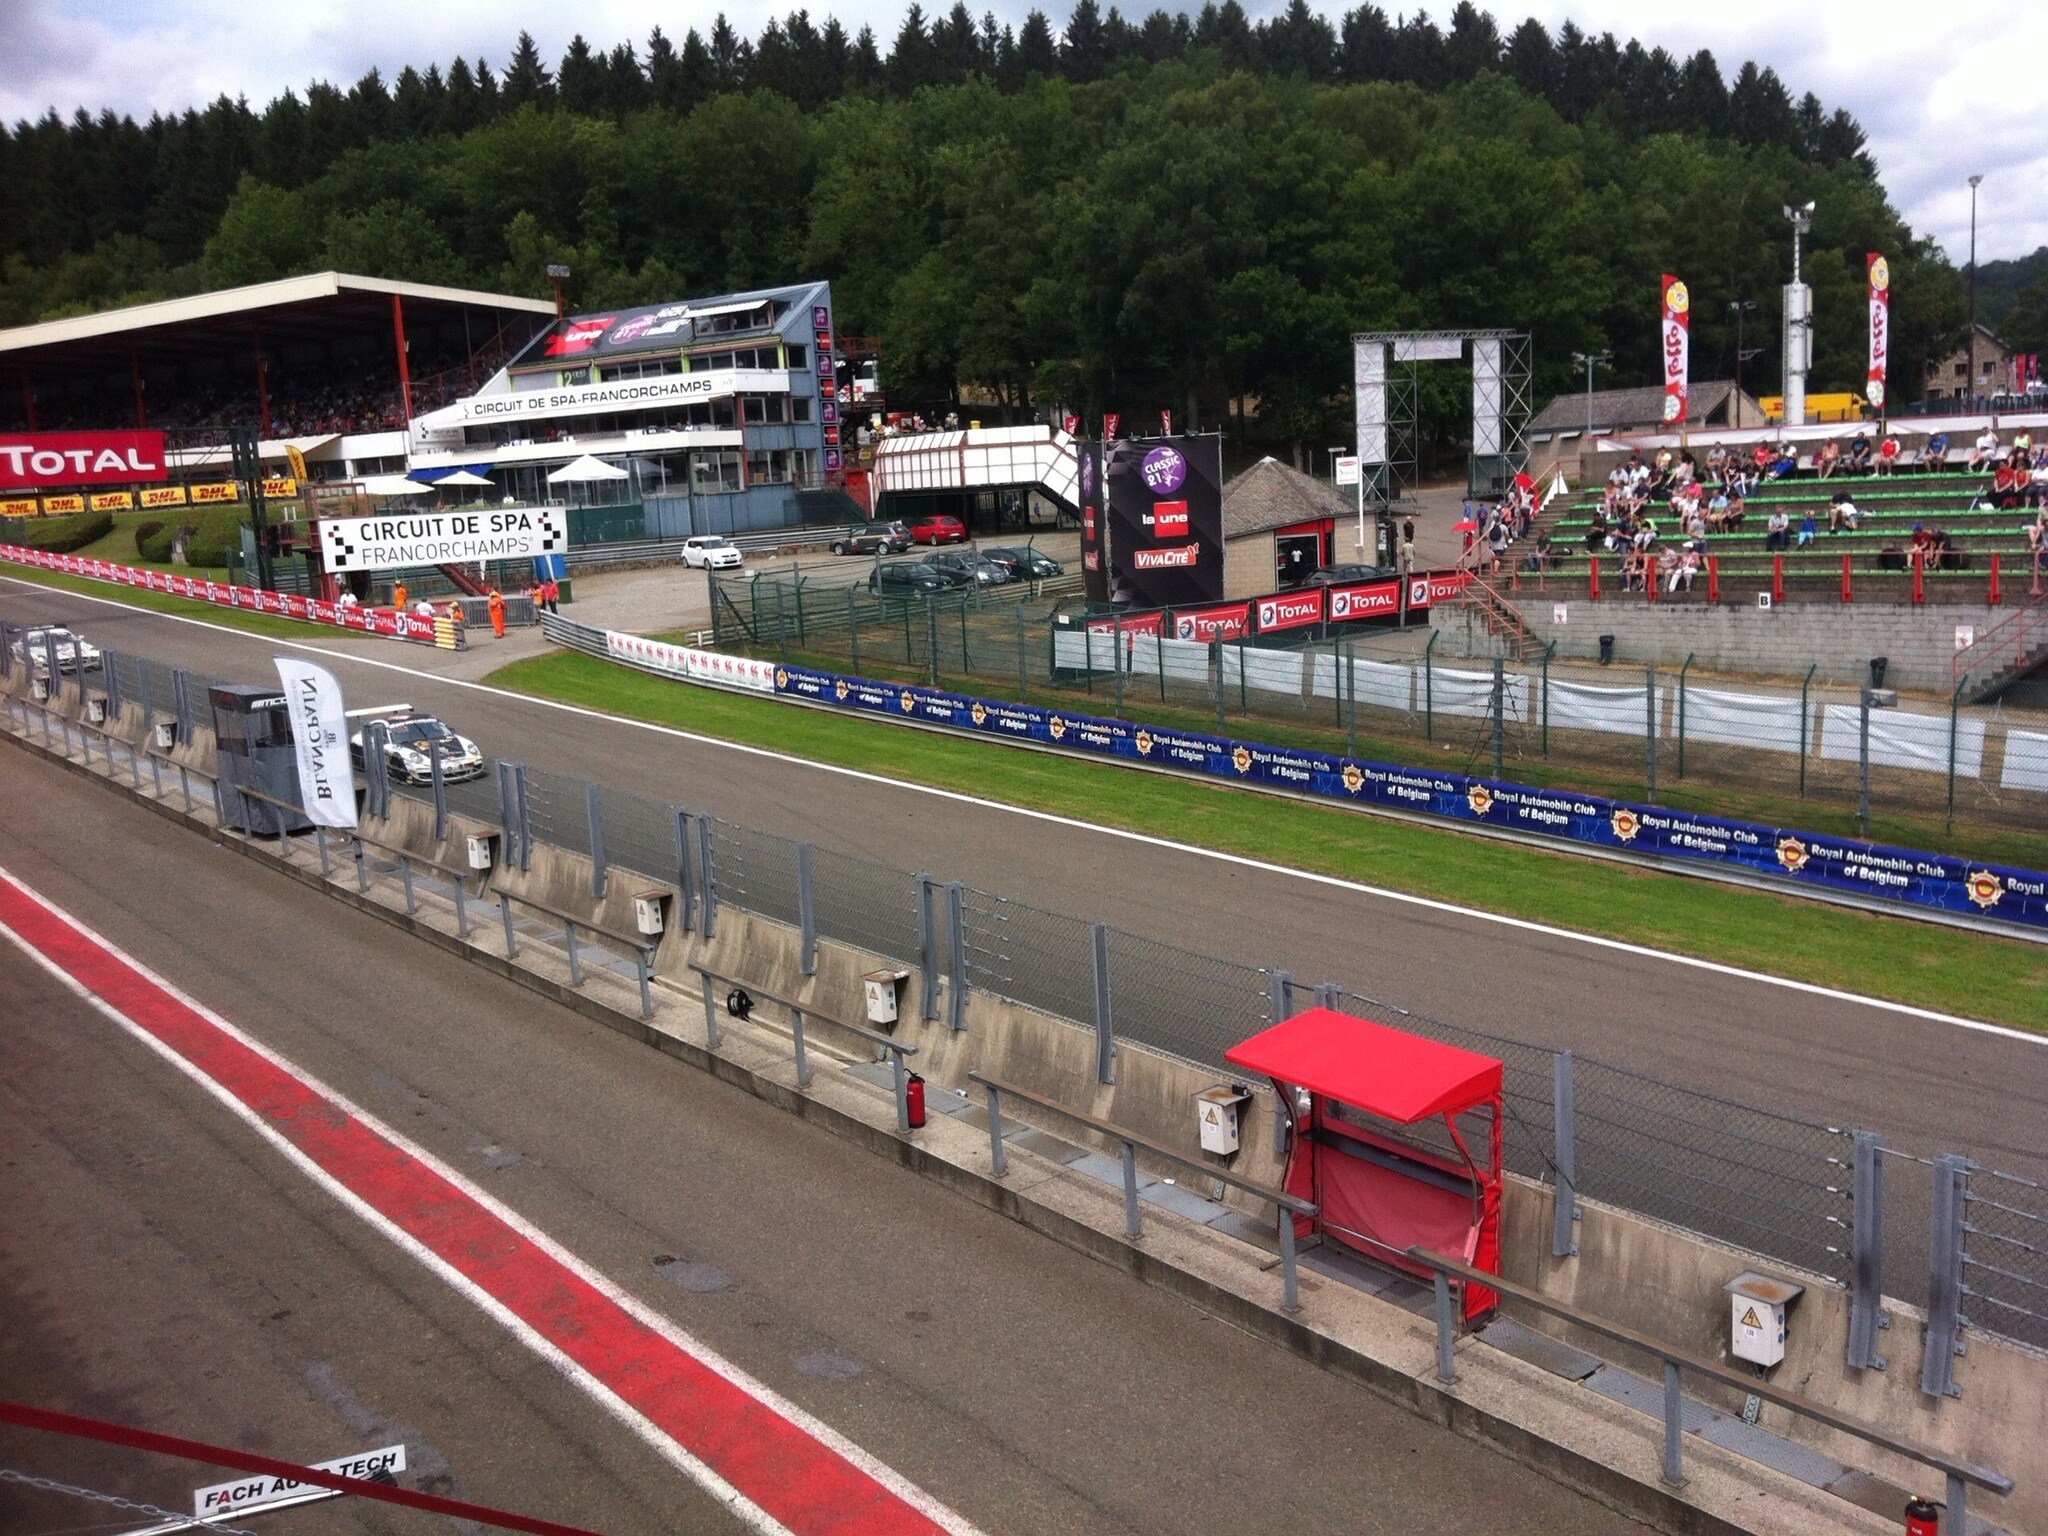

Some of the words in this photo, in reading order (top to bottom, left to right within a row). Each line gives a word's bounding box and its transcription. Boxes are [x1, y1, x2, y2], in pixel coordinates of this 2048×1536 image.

[474, 399, 523, 415] CIRCUIT
[528, 397, 546, 409] DE
[0, 446, 156, 476] TOTAL
[1145, 454, 1181, 474] CLASSIC
[1147, 474, 1163, 487] 21
[100, 496, 124, 507] DHL
[148, 491, 178, 502] DHL
[199, 487, 228, 499] DHL
[6, 503, 30, 514] DHL
[51, 499, 76, 510] DHL
[1142, 514, 1156, 525] la
[1160, 512, 1188, 524] une
[360, 518, 444, 542] CIRCUIT
[452, 516, 480, 535] DE
[490, 513, 532, 532] SPA
[362, 538, 530, 564] FRANCORCHAMPS
[1430, 586, 1462, 597] TOTA
[1351, 594, 1394, 608] TOTAL
[1760, 596, 1768, 606] B
[1278, 604, 1317, 619] TOTAL
[407, 618, 433, 634] TOTAL
[1198, 618, 1242, 632] TOTAL
[1152, 734, 1170, 746] Royal
[1171, 737, 1206, 751] Automobile
[1206, 742, 1222, 754] Club
[1171, 748, 1178, 757] of
[1179, 750, 1204, 762] Belgium
[1252, 750, 1272, 764] Royal
[1272, 755, 1312, 770] Automobile
[1312, 760, 1330, 772] Club
[1272, 766, 1280, 775] of
[1280, 767, 1310, 781] Belgium
[1365, 770, 1386, 784] Royal
[1388, 772, 1433, 790] Automobile
[1434, 780, 1454, 792] Club
[1388, 786, 1396, 796] of
[1398, 788, 1430, 801] Belgium
[1494, 790, 1518, 804] Royal
[1521, 794, 1572, 812] Automobile
[1574, 802, 1596, 816] Club
[1520, 807, 1530, 818] of
[1530, 809, 1568, 825] Belgium
[1642, 814, 1670, 830] Royal
[1672, 820, 1731, 840] Automobile
[1734, 830, 1758, 844] Club
[1670, 834, 1682, 845] of
[1684, 836, 1726, 853] Belgium
[1812, 844, 1843, 860] Royal
[1846, 850, 1914, 872] Automobile
[1916, 862, 1945, 878] Club
[1844, 865, 1856, 878] of
[1860, 866, 1909, 887] Belgium
[2008, 878, 2044, 896] Royal
[205, 1482, 264, 1508] FACH
[339, 1453, 396, 1478] TECH
